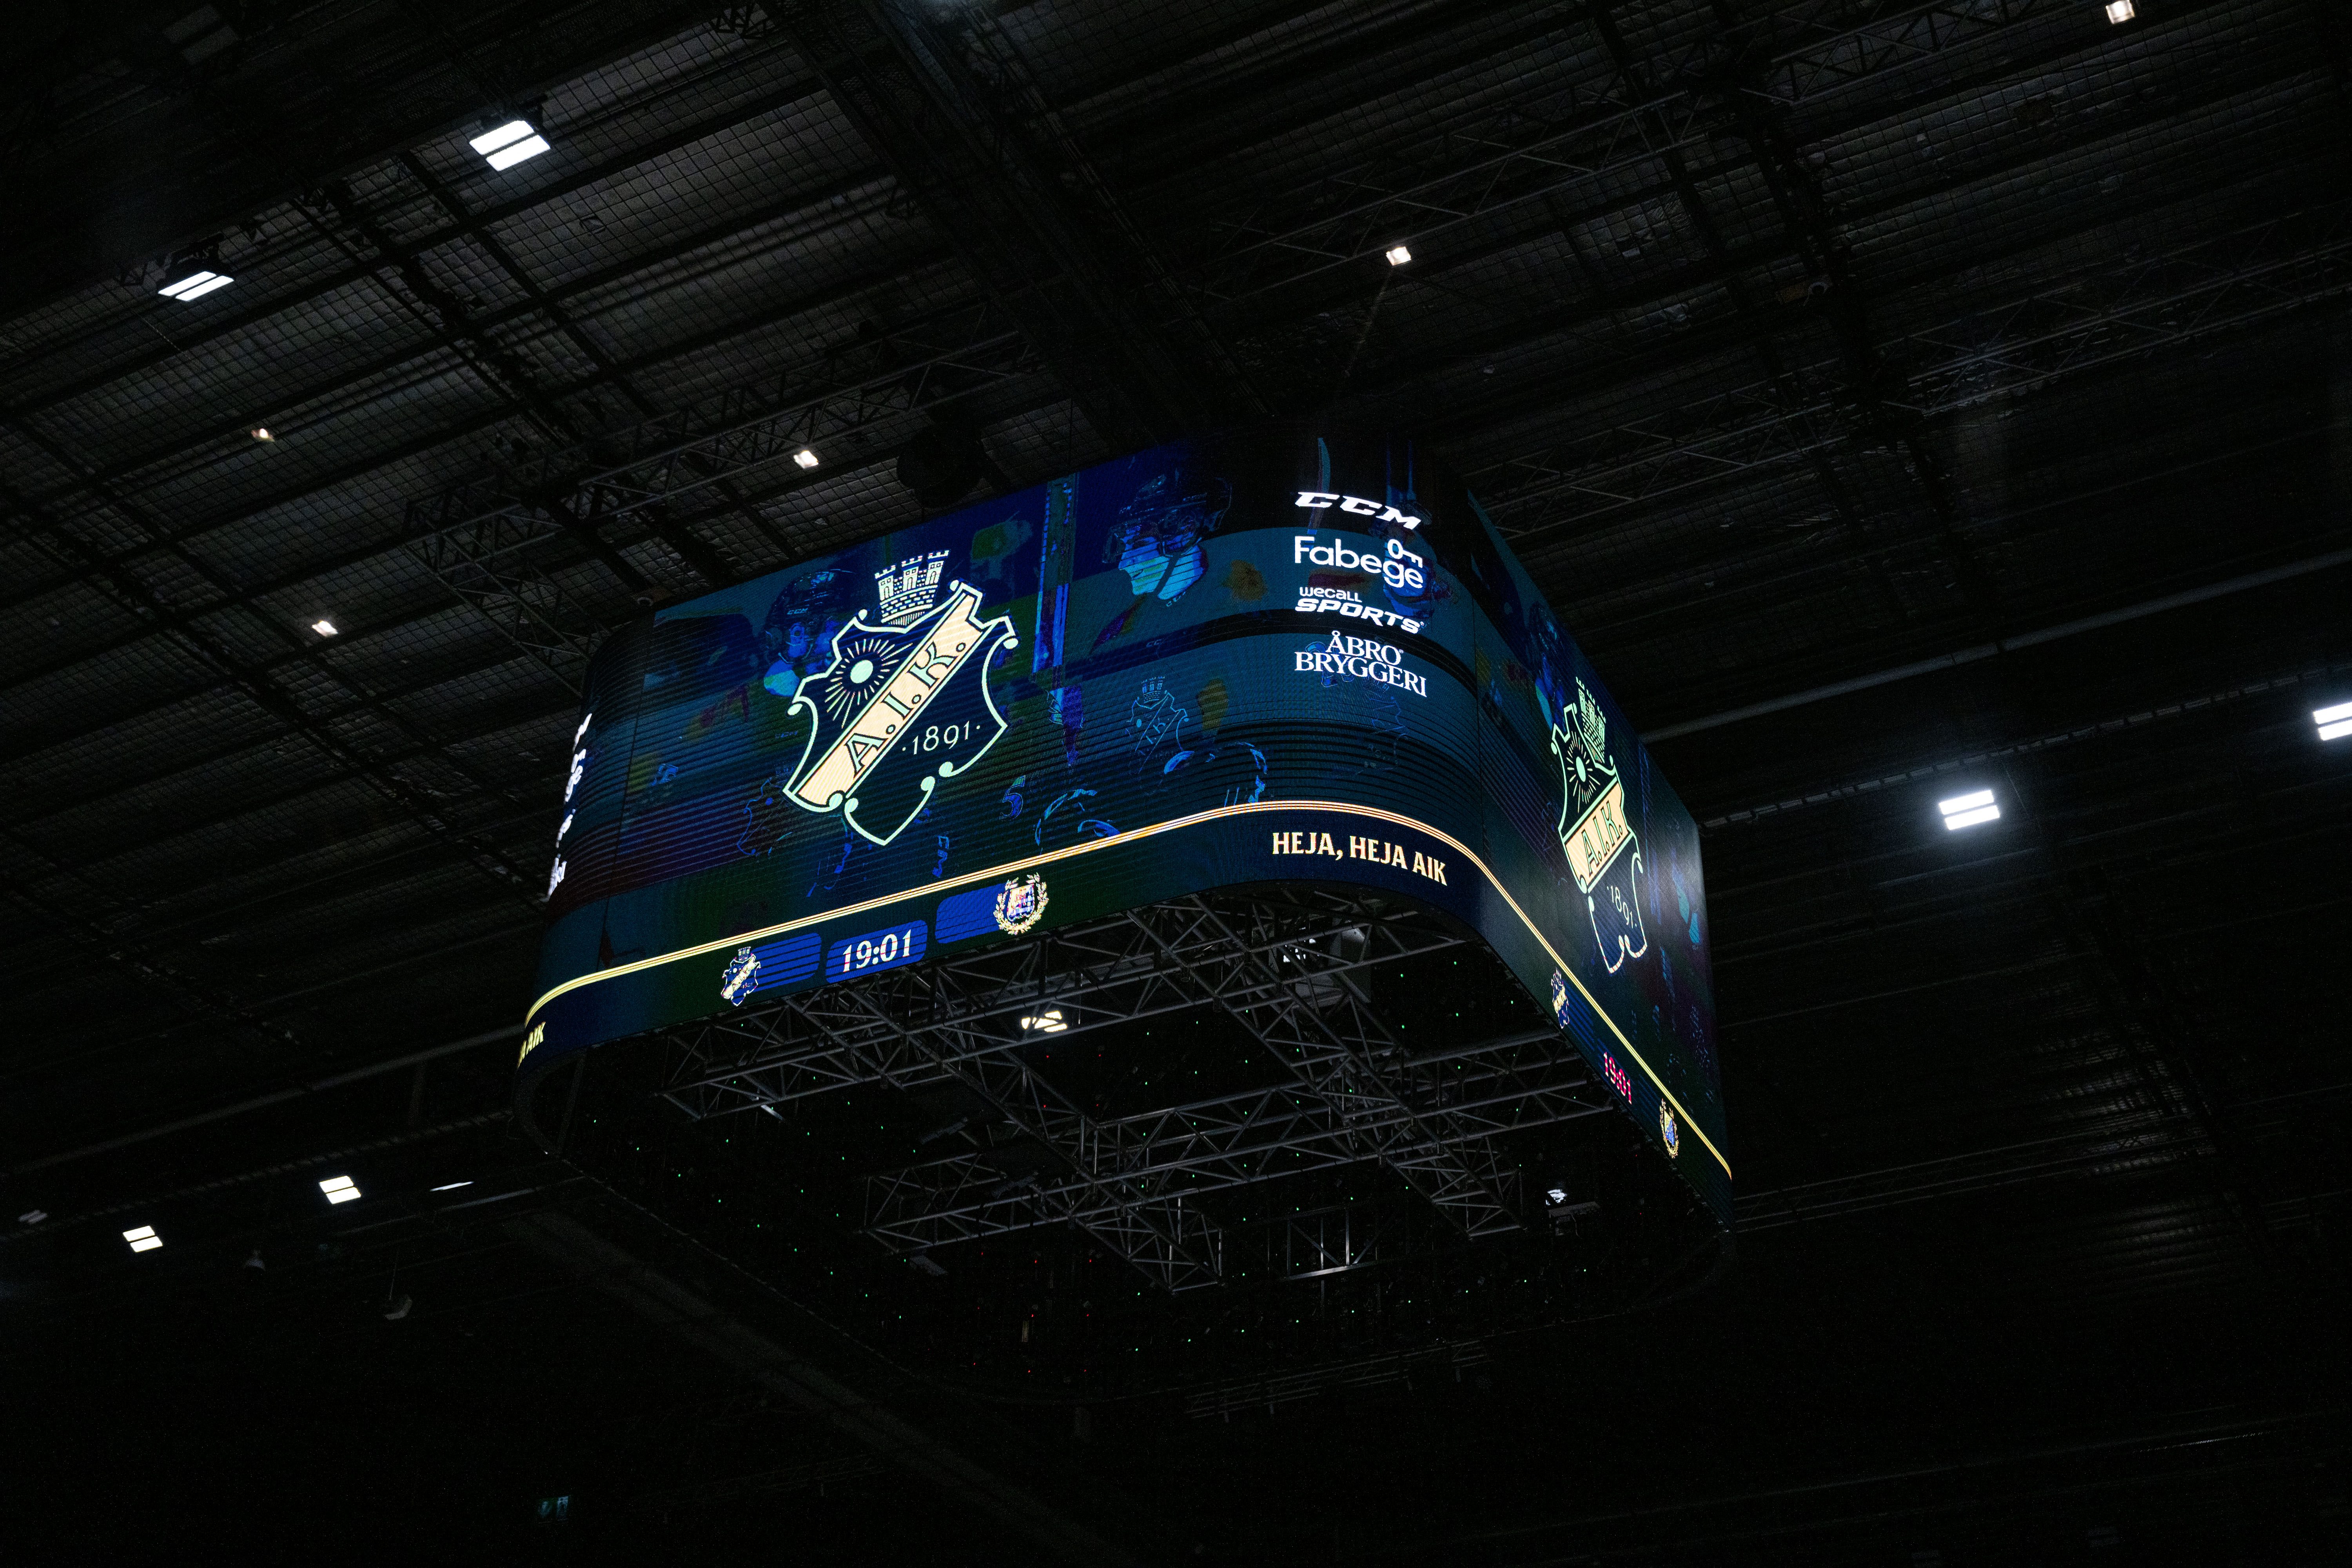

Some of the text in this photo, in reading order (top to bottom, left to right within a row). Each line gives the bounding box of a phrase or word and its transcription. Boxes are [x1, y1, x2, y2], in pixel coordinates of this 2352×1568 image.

[1295, 492, 1421, 530] CCM
[1295, 536, 1423, 589] Fabege
[1299, 587, 1362, 603] wecall
[1294, 652, 1427, 697] BRYGGERI
[1272, 832, 1447, 886] HEJA, HEJA AIK
[843, 929, 911, 973] 19:01
[526, 1021, 546, 1055] AIK
[1604, 1051, 1632, 1104] 19:01
